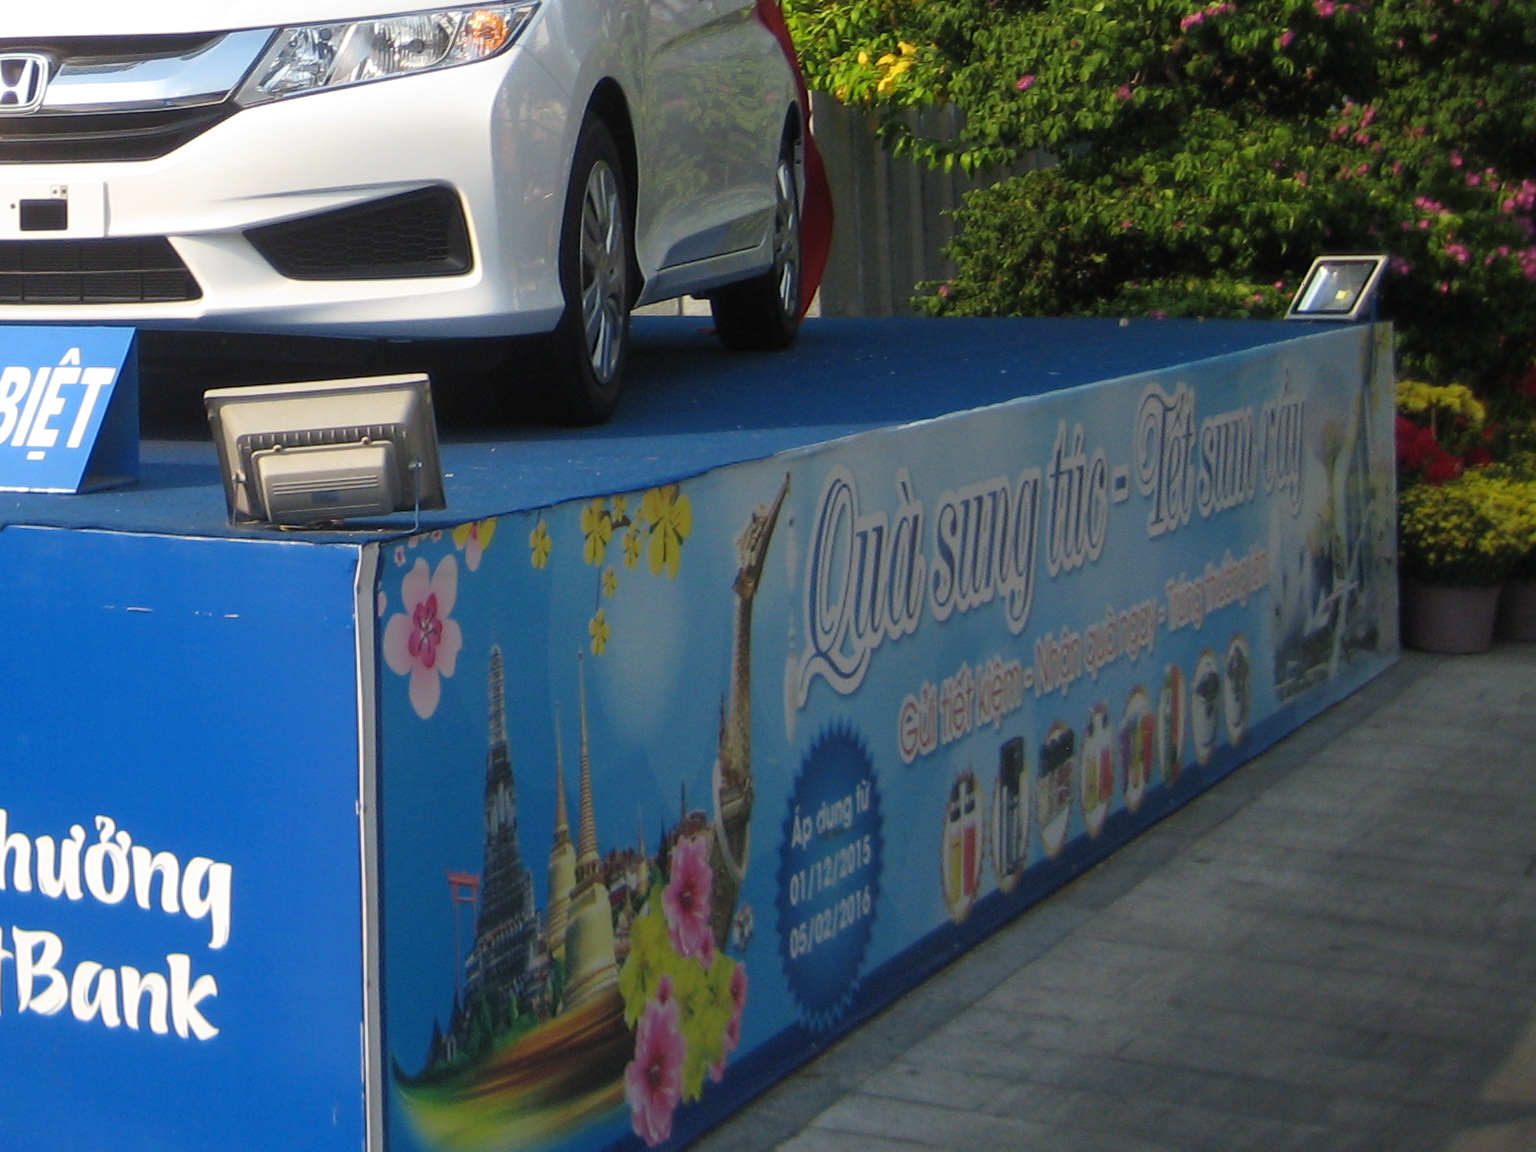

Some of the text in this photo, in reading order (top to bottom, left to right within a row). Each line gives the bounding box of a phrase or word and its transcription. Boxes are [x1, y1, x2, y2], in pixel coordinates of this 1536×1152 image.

[797, 465, 925, 706] Quà
[930, 467, 1041, 635] sung
[790, 835, 872, 906] 01/12/2015
[789, 885, 872, 959] 05/02/2016
